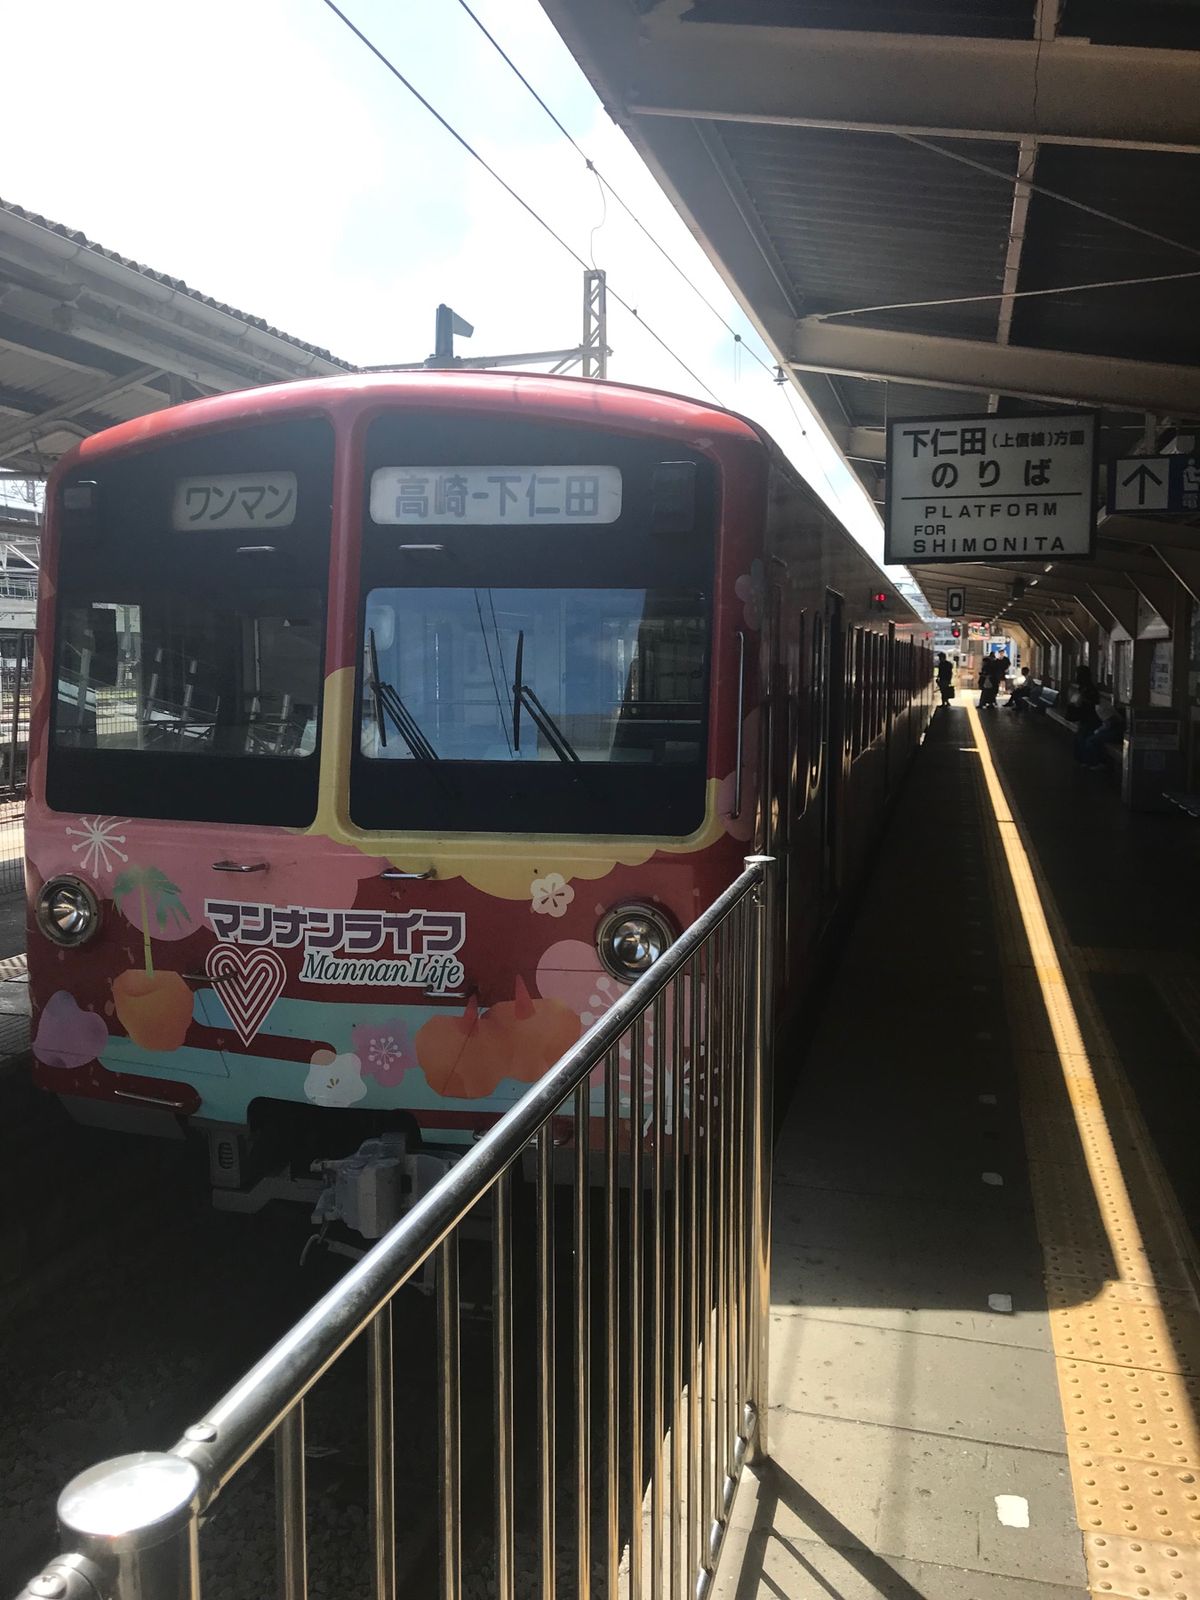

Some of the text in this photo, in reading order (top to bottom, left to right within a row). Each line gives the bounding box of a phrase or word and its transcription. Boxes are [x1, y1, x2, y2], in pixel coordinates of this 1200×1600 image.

[931, 458, 1052, 489] のりば
[185, 484, 293, 522] ワンマン
[924, 502, 1058, 519] PLATFORM
[914, 524, 946, 536] FOR
[913, 536, 1065, 553] SHIMONITA
[205, 899, 464, 953] マンナンライフ
